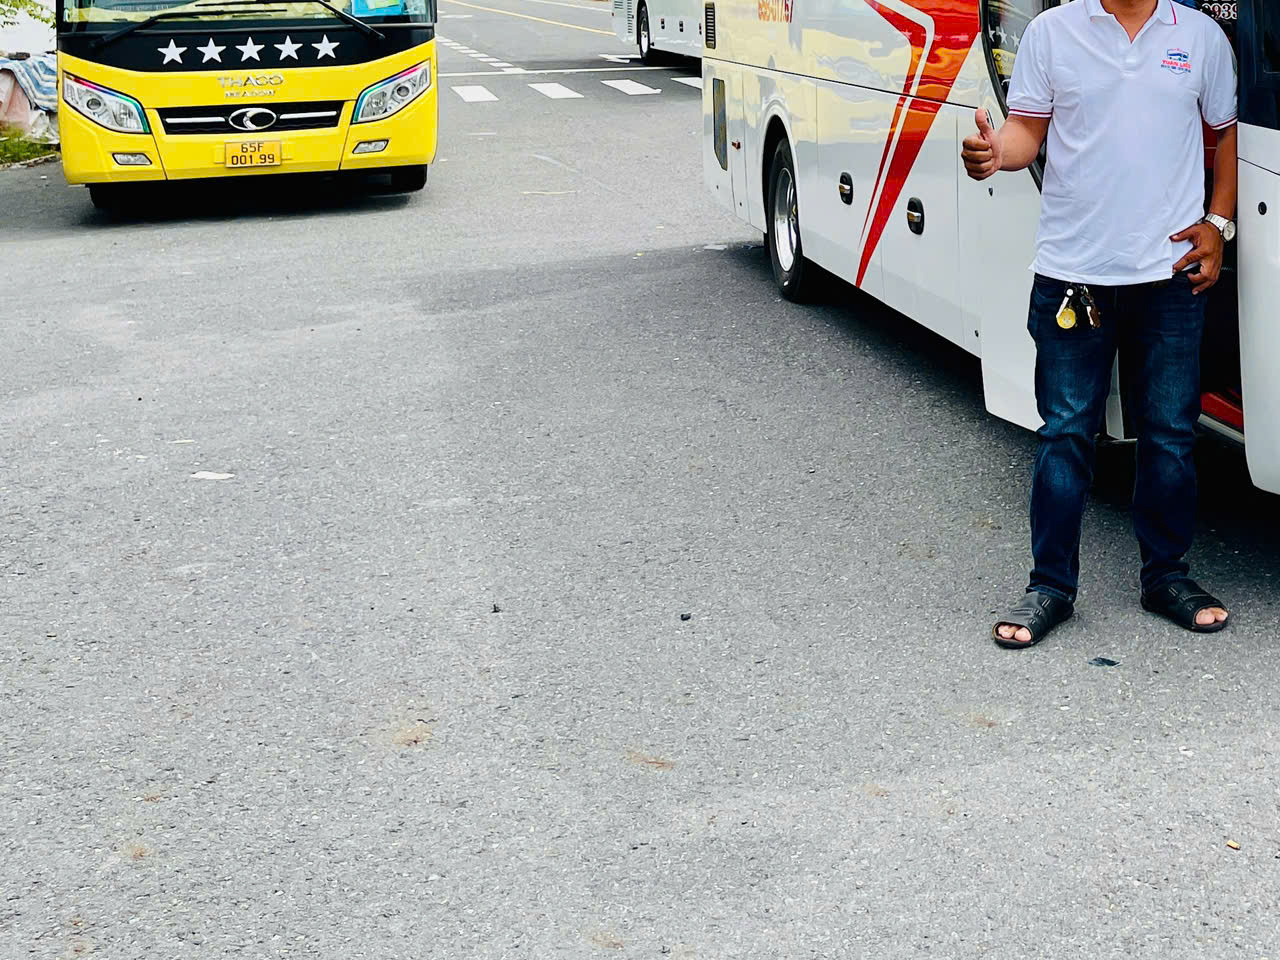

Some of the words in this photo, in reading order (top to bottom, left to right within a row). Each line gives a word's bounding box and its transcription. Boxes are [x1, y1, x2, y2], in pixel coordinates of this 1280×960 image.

[216, 75, 284, 88] THACO
[241, 143, 264, 153] 65F
[231, 153, 275, 166] 001.99
